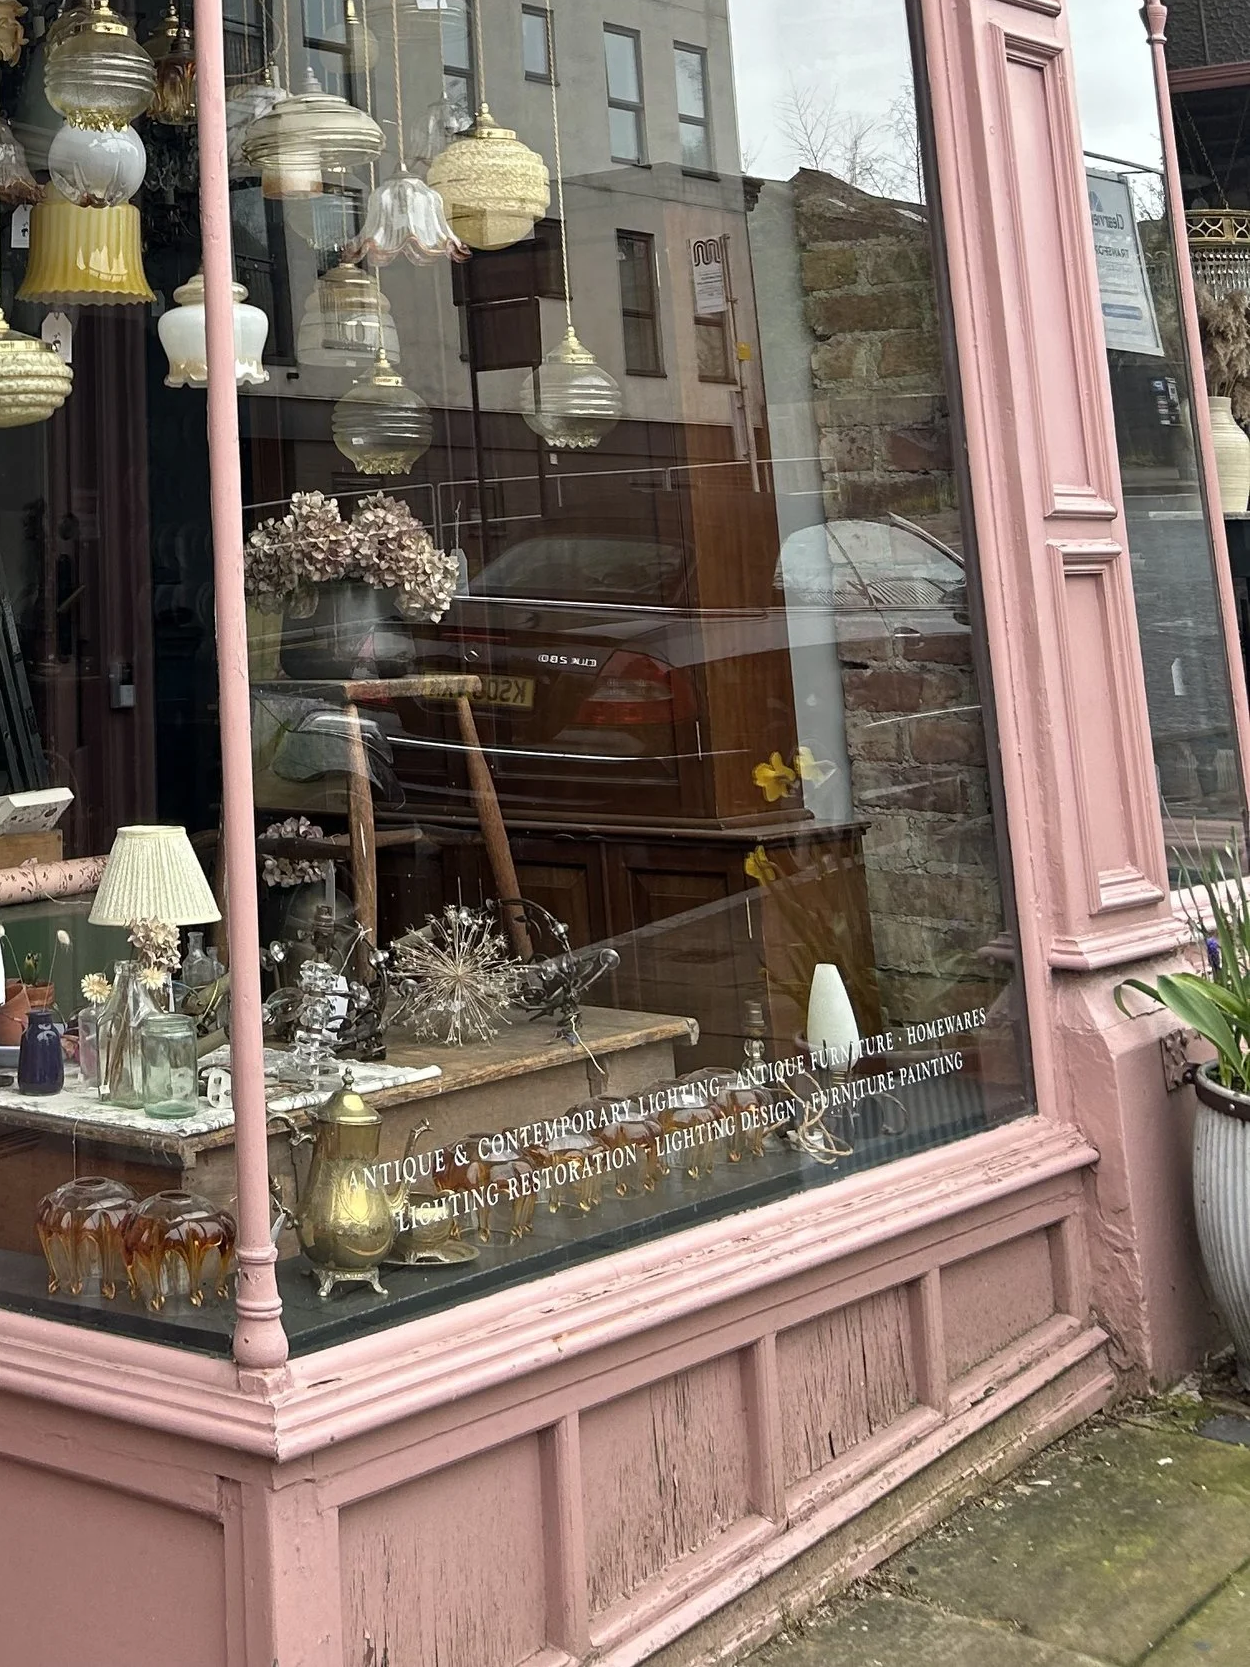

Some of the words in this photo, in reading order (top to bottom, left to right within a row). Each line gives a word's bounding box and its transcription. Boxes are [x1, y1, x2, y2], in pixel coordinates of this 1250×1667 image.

[349, 1147, 446, 1190] ANTIQUE
[454, 1144, 470, 1168] &
[478, 1099, 632, 1160] CONTEMPORARY
[639, 1077, 720, 1118] LIGHTING
[735, 1054, 806, 1090] ANTIQUE
[809, 1031, 894, 1072] FURNITURE
[906, 1007, 987, 1046] HOMEWARES
[398, 1182, 500, 1232] LIGHTING
[508, 1143, 638, 1201] RESTORATION
[655, 1115, 735, 1157] LIGHTING
[741, 1098, 797, 1130] DESIGN
[810, 1071, 895, 1113] FURNITURE
[899, 1051, 964, 1087] PAINTING
